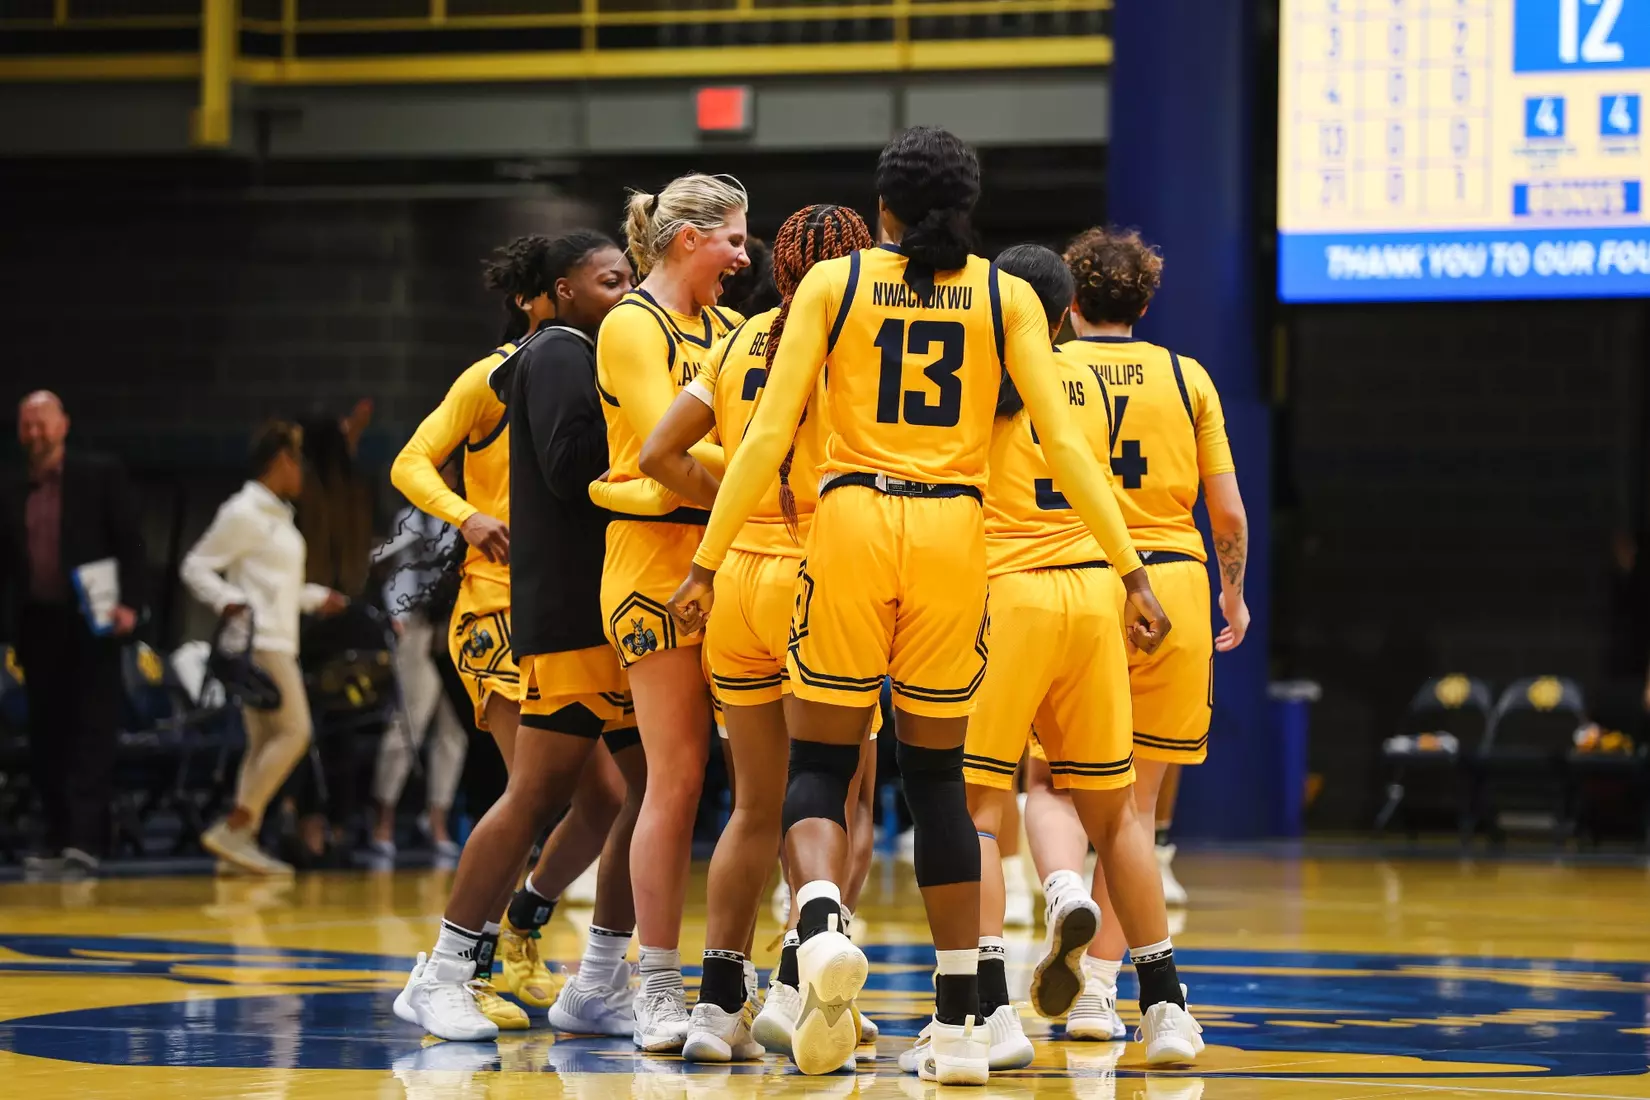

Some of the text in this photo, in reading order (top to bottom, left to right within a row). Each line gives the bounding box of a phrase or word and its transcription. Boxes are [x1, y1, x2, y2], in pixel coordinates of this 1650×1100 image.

[1558, 0, 1625, 64] 12
[1325, 245, 1424, 279] THANK
[1428, 243, 1487, 278] YOU
[1491, 242, 1530, 277] TO
[1533, 240, 1595, 276] OUR
[873, 318, 965, 427] 13
